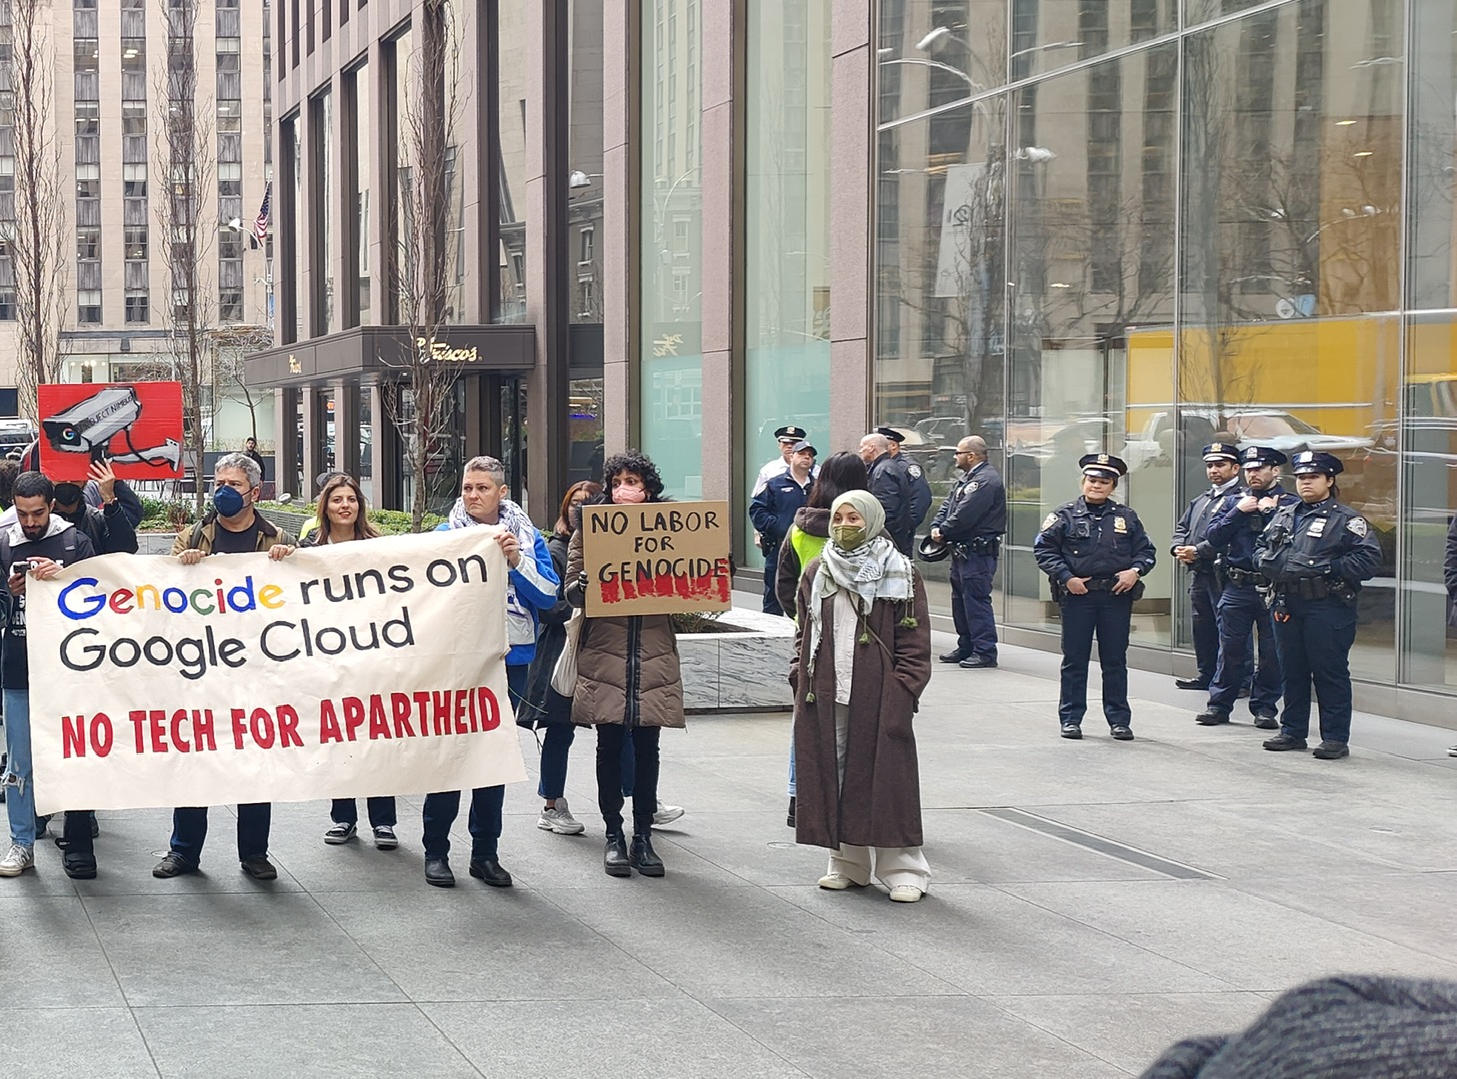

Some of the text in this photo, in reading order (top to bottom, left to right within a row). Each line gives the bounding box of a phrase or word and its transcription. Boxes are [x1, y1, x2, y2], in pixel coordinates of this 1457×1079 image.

[591, 510, 720, 535] NO LABOR
[634, 536, 675, 553] FOR
[57, 575, 286, 620] Genocide
[300, 564, 415, 605] runs
[425, 553, 488, 588] on
[598, 557, 730, 584] GENOCIDE
[59, 606, 415, 680] Google Cloud
[61, 686, 501, 759] NO TECH FOR APARTHEID
